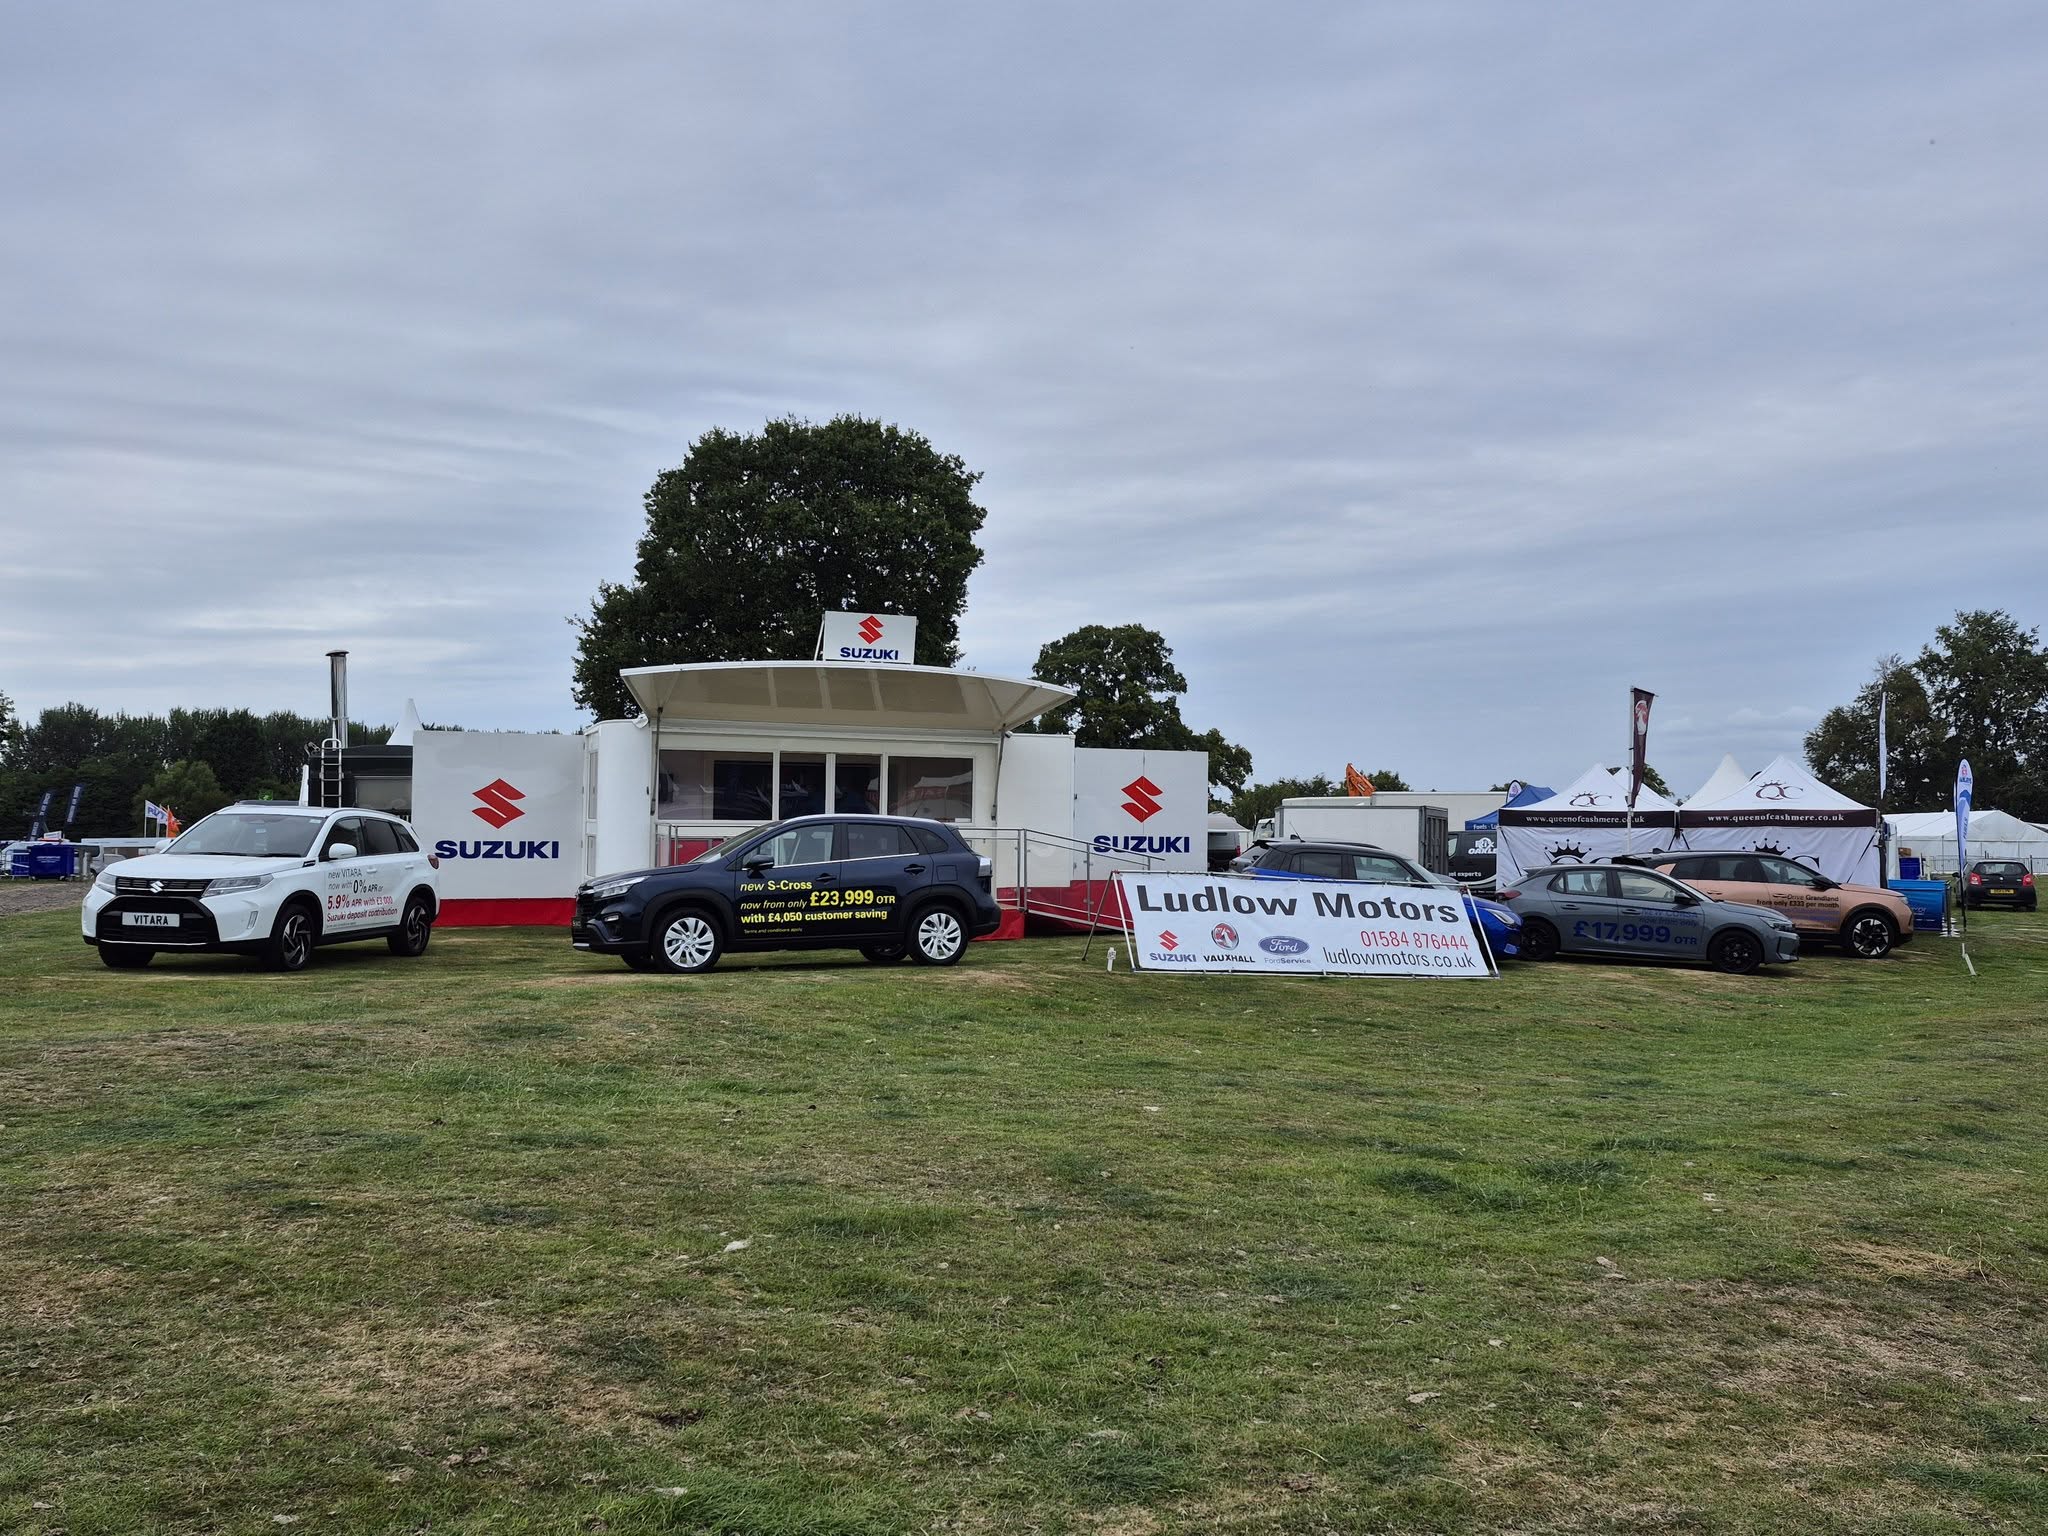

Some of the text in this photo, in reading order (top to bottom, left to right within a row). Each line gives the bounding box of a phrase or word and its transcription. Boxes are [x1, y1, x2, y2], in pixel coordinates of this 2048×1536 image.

[840, 647, 898, 660] SUZUKI
[1707, 813, 1844, 822] www.queenofcashmere.co.uk
[435, 840, 559, 859] SUZUKI
[1093, 835, 1190, 853] SUZUKI
[341, 868, 362, 878] VITARA
[353, 879, 366, 893] 0%
[367, 884, 378, 893] APR
[740, 880, 812, 892] new S-Cross
[328, 894, 350, 910] 5.9%
[351, 898, 362, 907] APR
[740, 890, 896, 910] now from only £23,999 OTR
[1137, 885, 1459, 923] Ludlow Motors
[1805, 894, 1839, 902] Grandland
[134, 914, 169, 925] VITARA
[327, 907, 397, 922] Suzuki deposit contribution
[741, 909, 888, 924] with £4,050 customer saving
[1573, 920, 1697, 945] £17,999 OTR
[1270, 939, 1298, 952] Ford
[1360, 930, 1469, 950] 01584 876444
[1150, 952, 1197, 963] SUZUKI
[1203, 954, 1256, 963] VAUXHALL
[1323, 946, 1476, 968] ludlowmotors.co.uk
